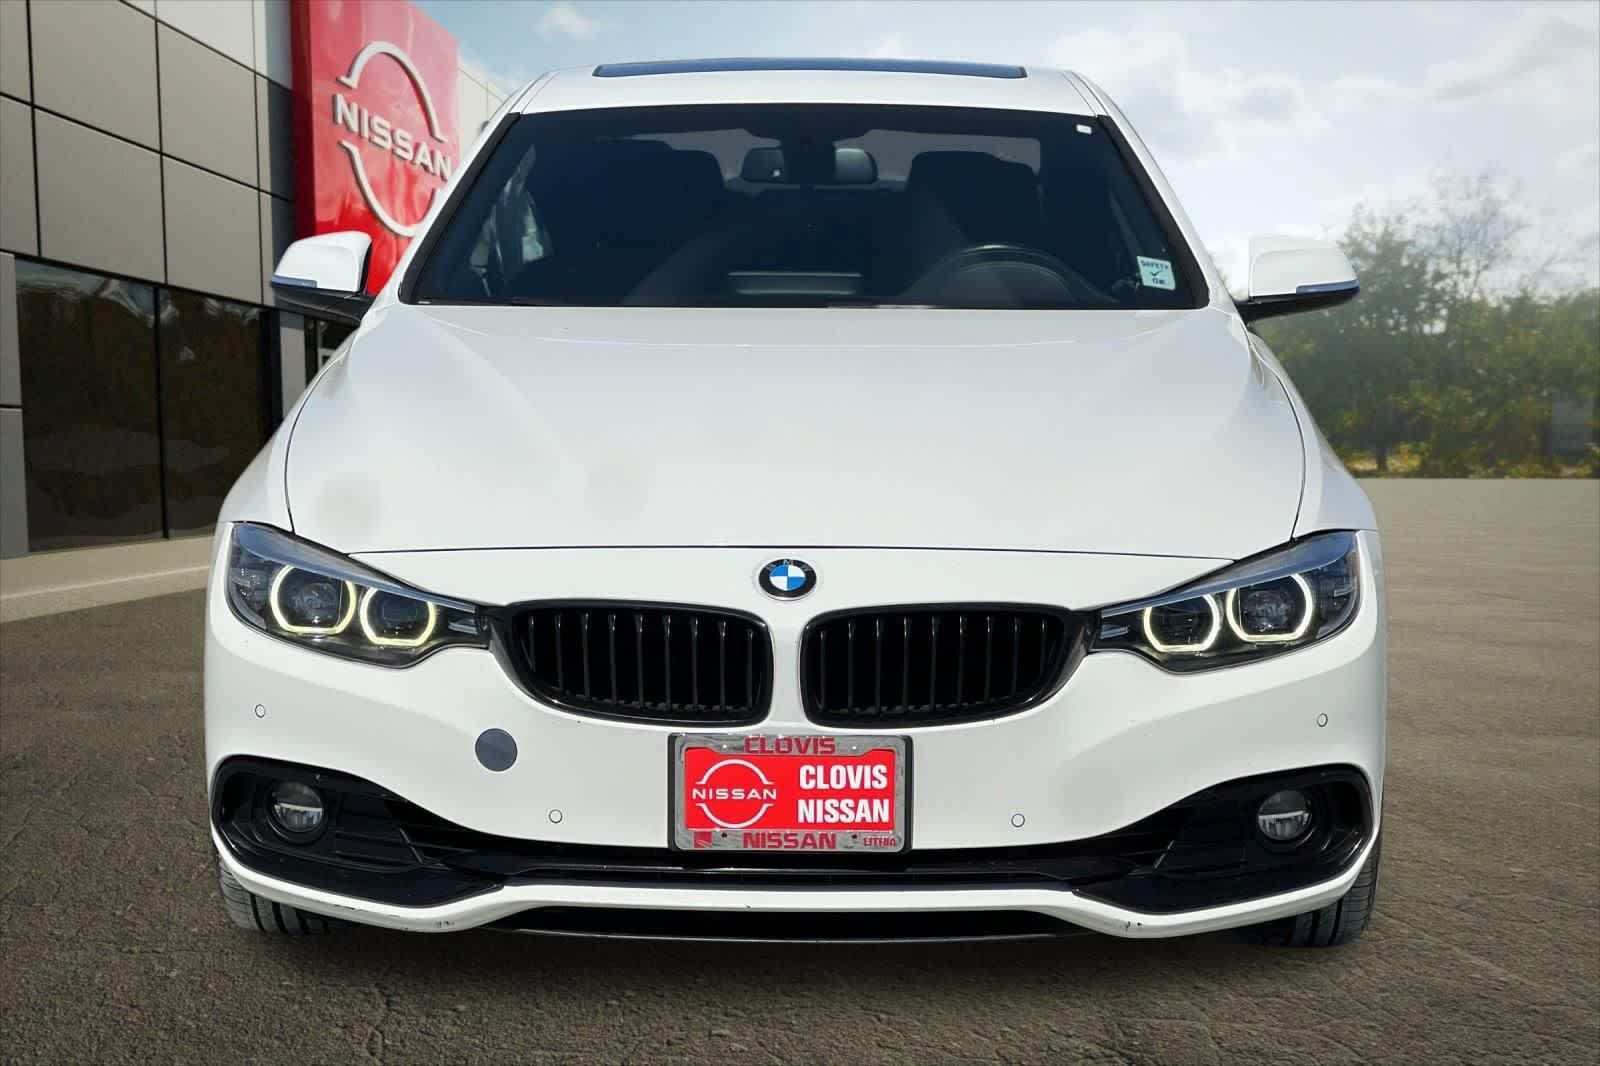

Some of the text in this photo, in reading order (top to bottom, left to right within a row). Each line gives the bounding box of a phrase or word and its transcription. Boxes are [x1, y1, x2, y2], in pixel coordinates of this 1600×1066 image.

[332, 93, 452, 182] NISSAN
[743, 736, 836, 754] CLOVIS
[799, 764, 888, 790] CLOVIS
[692, 788, 777, 800] NISSAN
[797, 799, 889, 823] NISSAN
[743, 832, 837, 849] NISSAN
